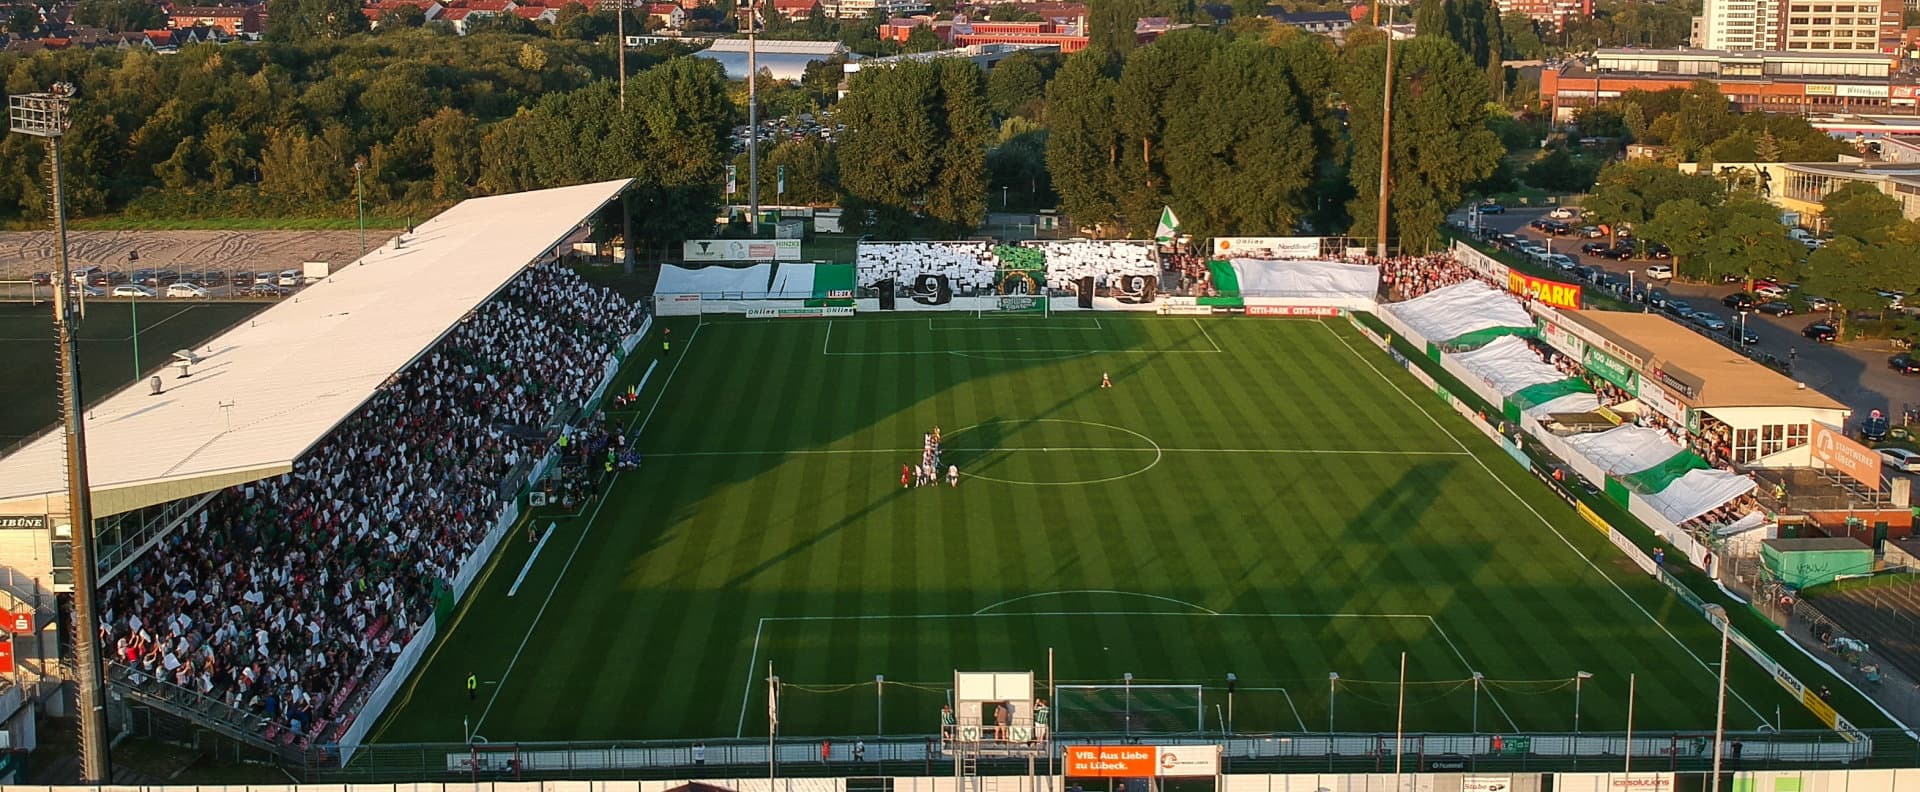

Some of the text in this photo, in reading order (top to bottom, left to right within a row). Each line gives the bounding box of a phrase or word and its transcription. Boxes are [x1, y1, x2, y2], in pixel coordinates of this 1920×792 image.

[0, 518, 42, 527] IBÜNE
[1076, 751, 1149, 760] VfB. Aus Liebe
[1089, 761, 1128, 770] Lübeck.
